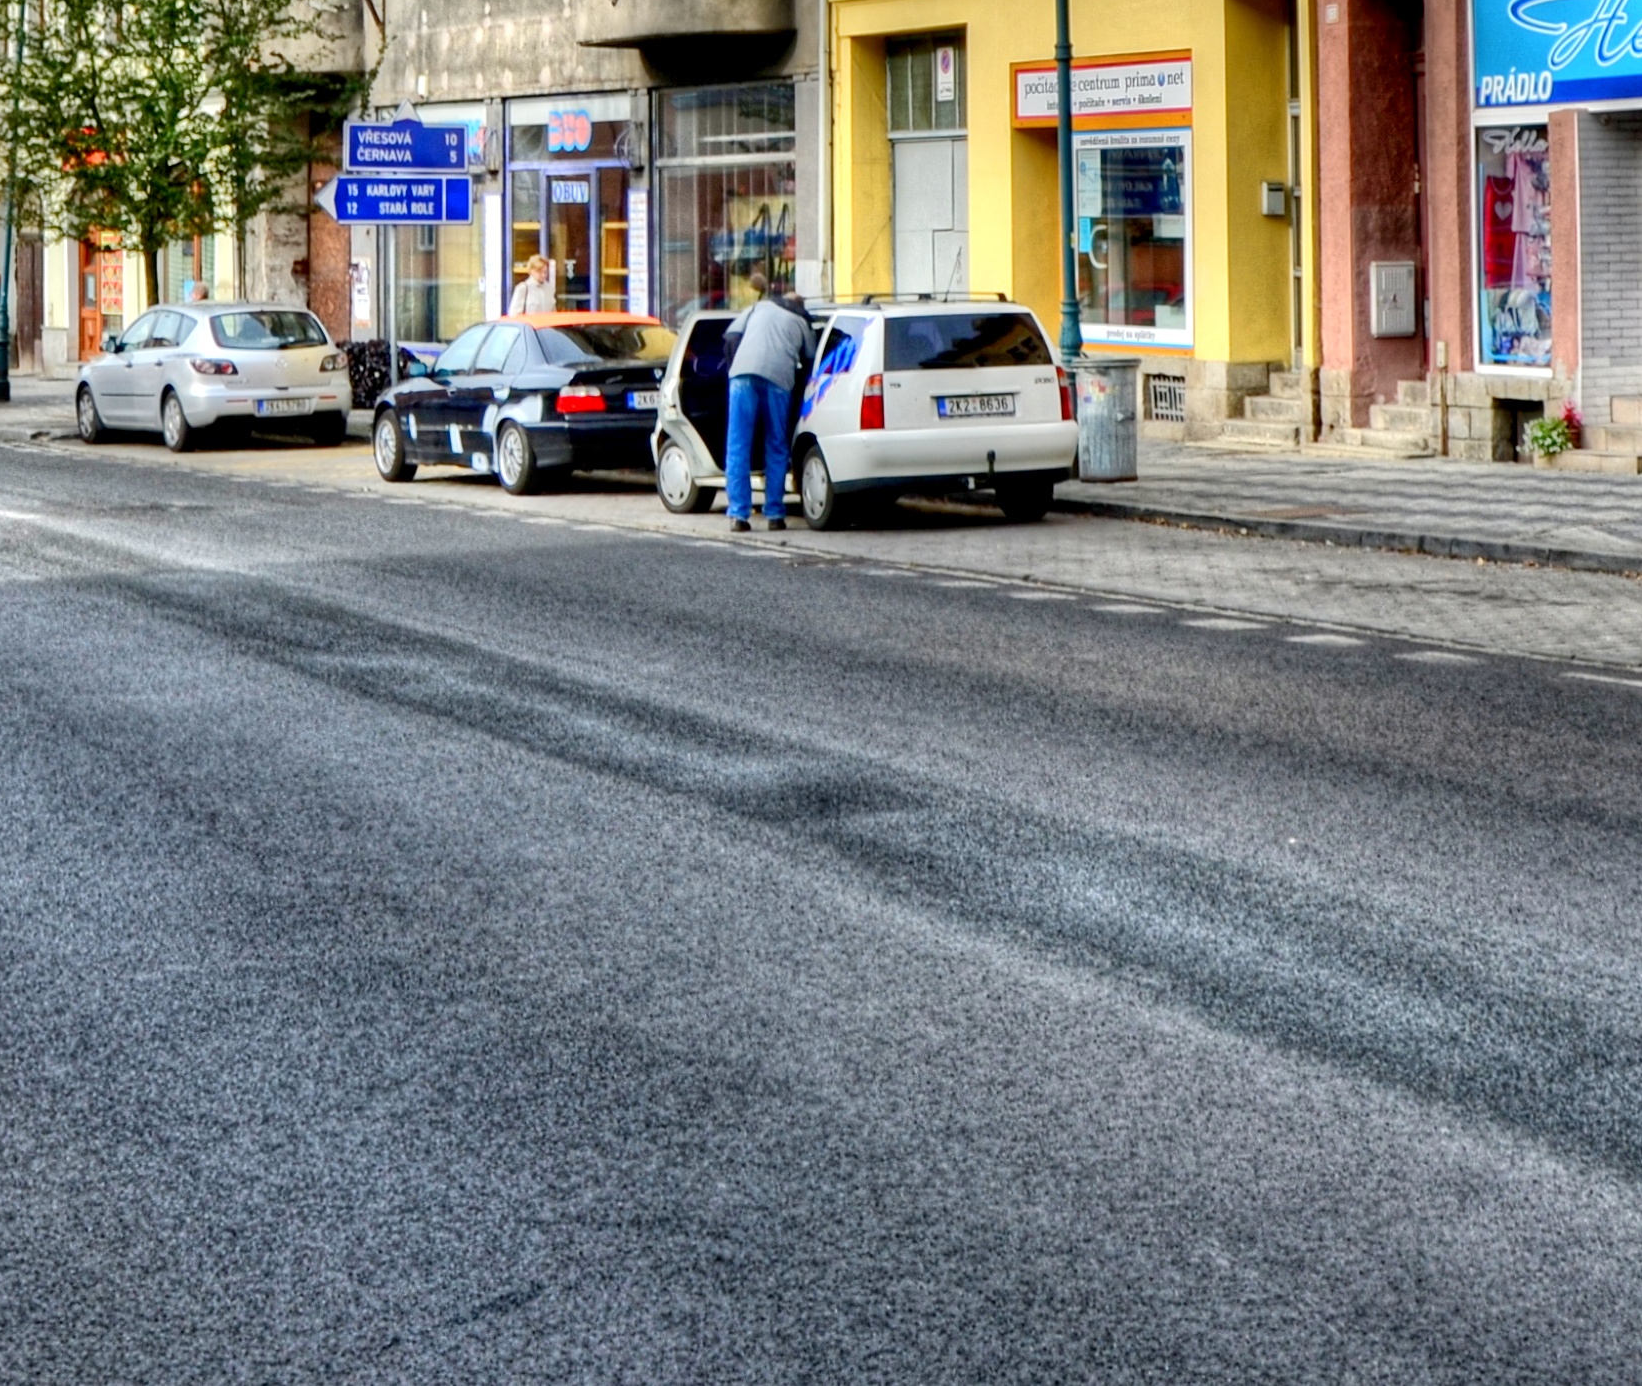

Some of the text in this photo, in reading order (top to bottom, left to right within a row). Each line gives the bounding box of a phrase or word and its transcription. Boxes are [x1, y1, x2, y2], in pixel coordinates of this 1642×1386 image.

[1078, 73, 1120, 93] centrum
[1125, 71, 1155, 93] prima
[1167, 67, 1184, 86] net
[1478, 66, 1554, 106] PRÁDLO
[1112, 94, 1131, 107] servis
[357, 128, 457, 146] VŘESOVÁ 10
[357, 146, 457, 163] ČERNAVA 5
[347, 184, 435, 197] 15 KARLOVY VARY
[554, 182, 586, 203] OBUV
[347, 199, 434, 215] 12 STARÁ ROLE
[949, 397, 1009, 414] 2K2 8636
